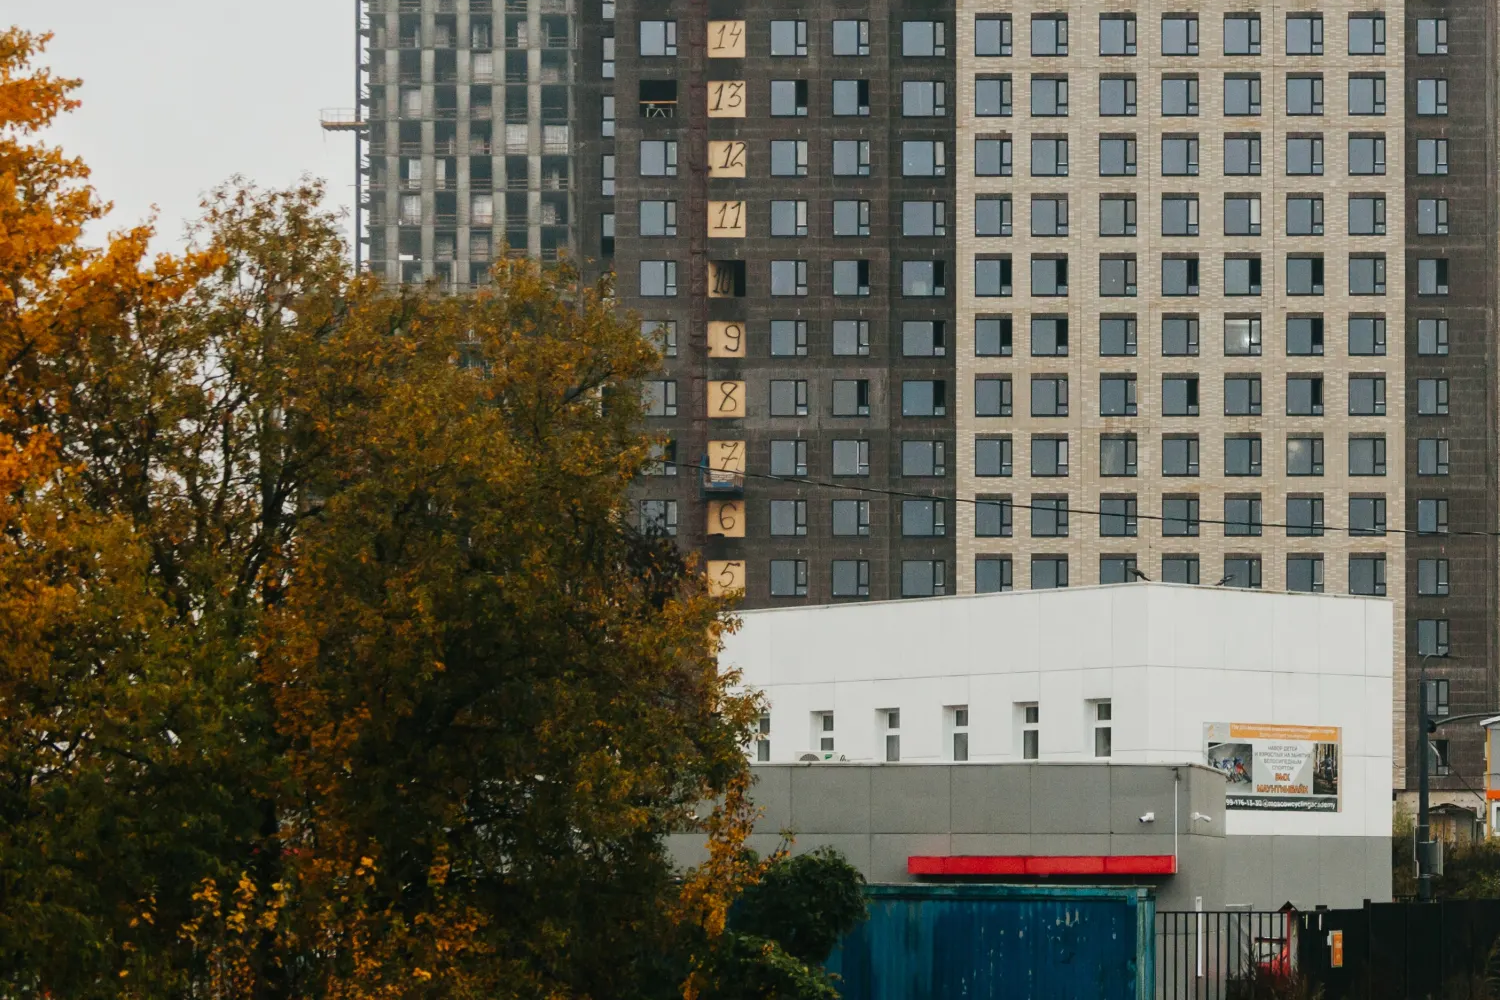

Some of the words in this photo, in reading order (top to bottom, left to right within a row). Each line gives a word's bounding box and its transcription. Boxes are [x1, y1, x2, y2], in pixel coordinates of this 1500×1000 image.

[712, 22, 742, 49] 14
[709, 82, 743, 111] 13
[718, 141, 746, 169] 12
[713, 200, 741, 229] 11
[712, 266, 730, 294] 10
[725, 324, 740, 352] 9
[719, 381, 738, 412] 8
[720, 442, 739, 470] 7
[719, 501, 737, 530] 6
[718, 562, 740, 588] 5
